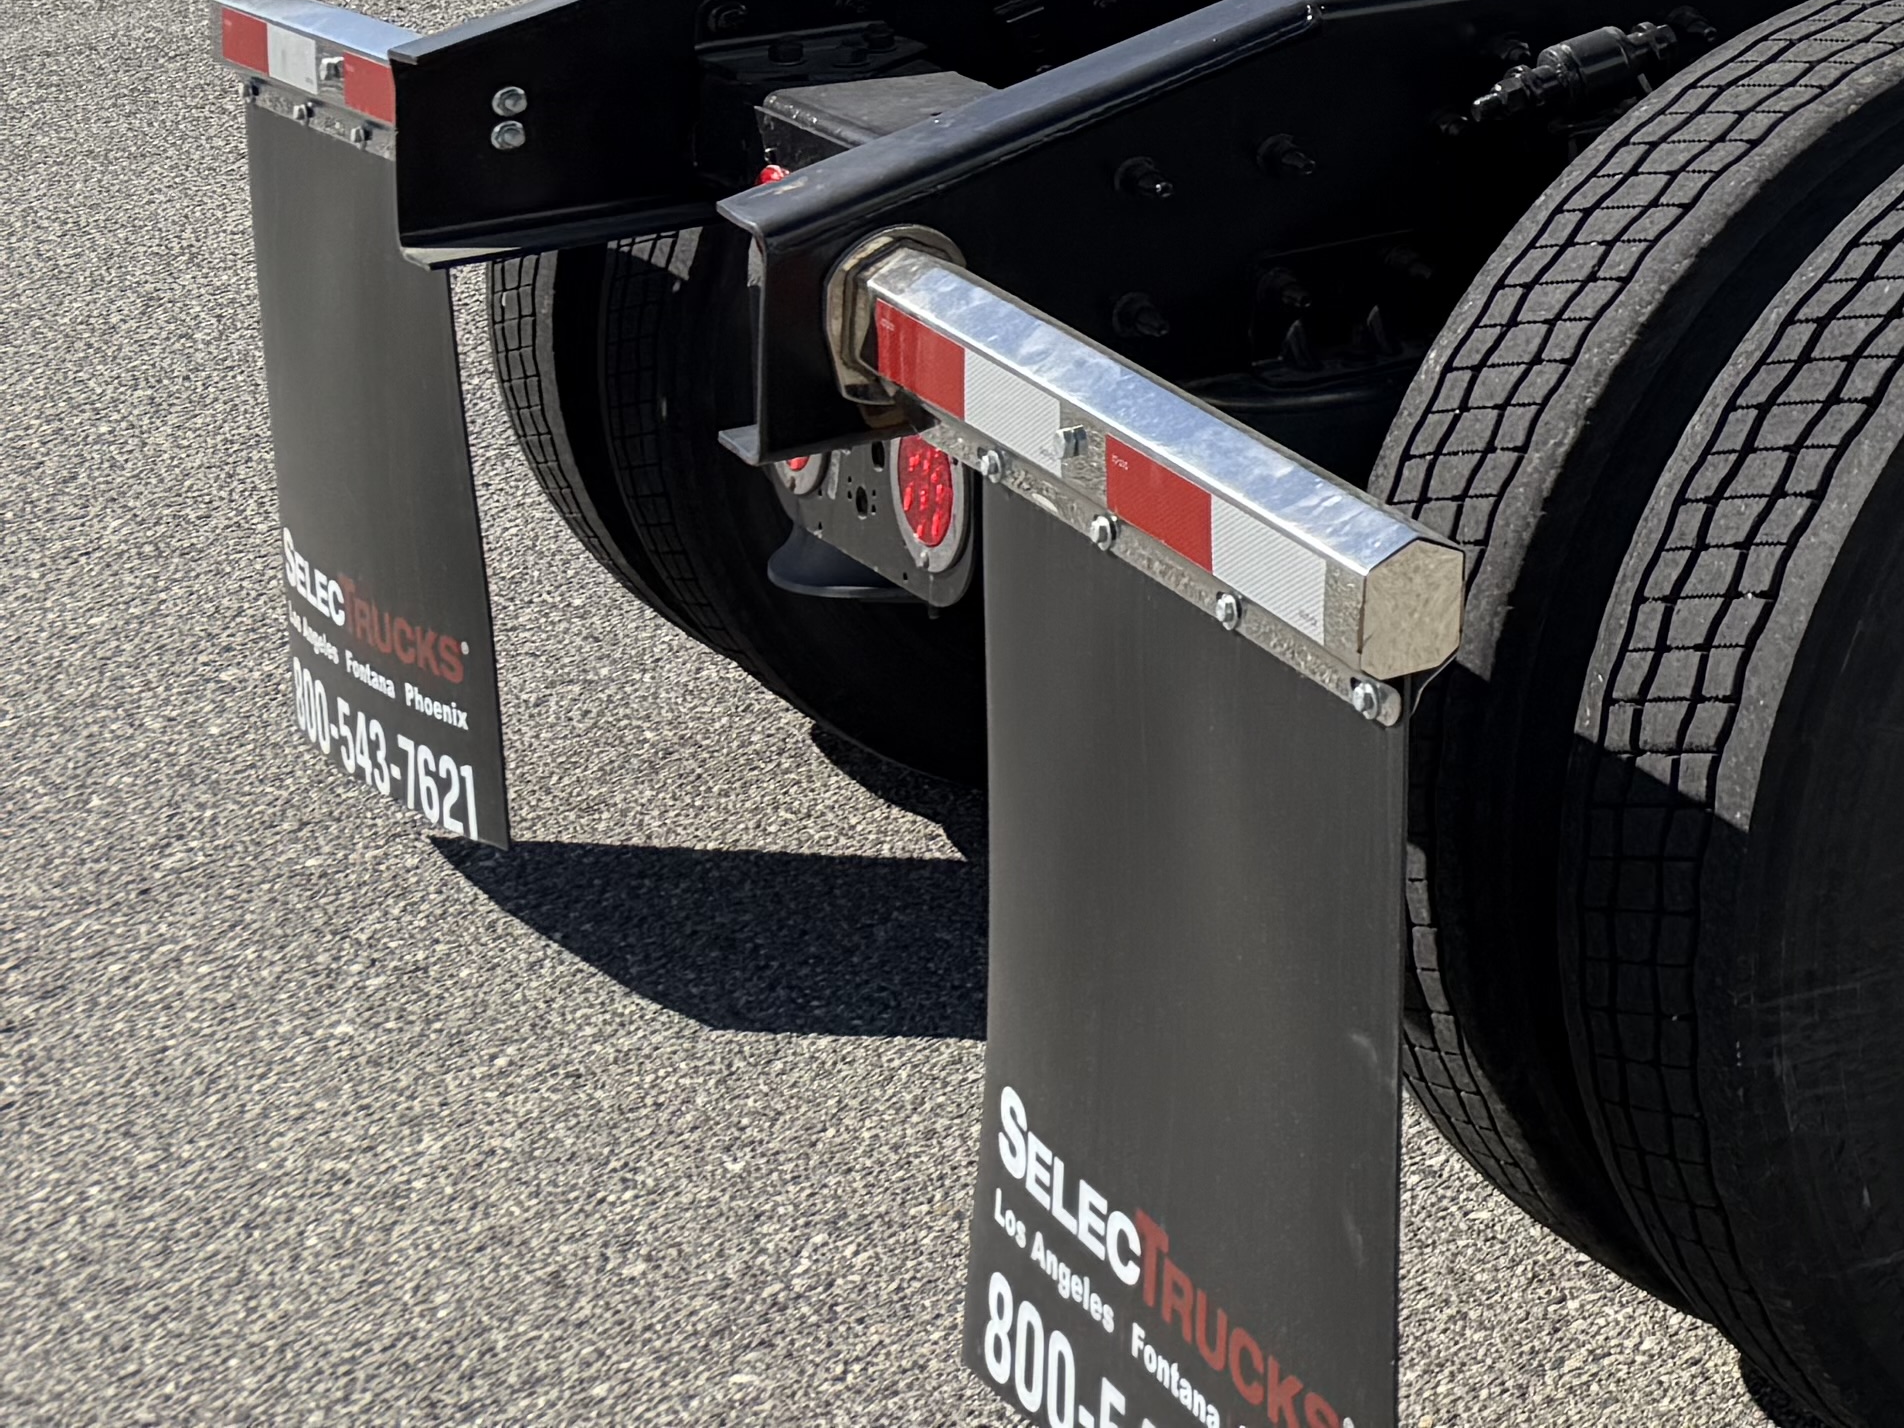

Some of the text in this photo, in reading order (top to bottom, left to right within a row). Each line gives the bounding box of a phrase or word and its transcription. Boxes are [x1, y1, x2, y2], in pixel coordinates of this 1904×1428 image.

[282, 527, 464, 684] SELECTRUCKS
[344, 649, 396, 699] Fontana
[404, 682, 469, 731] Phoenix
[292, 655, 479, 841] 800-543-7621
[994, 1187, 1221, 1428] Los Angeles Fontana
